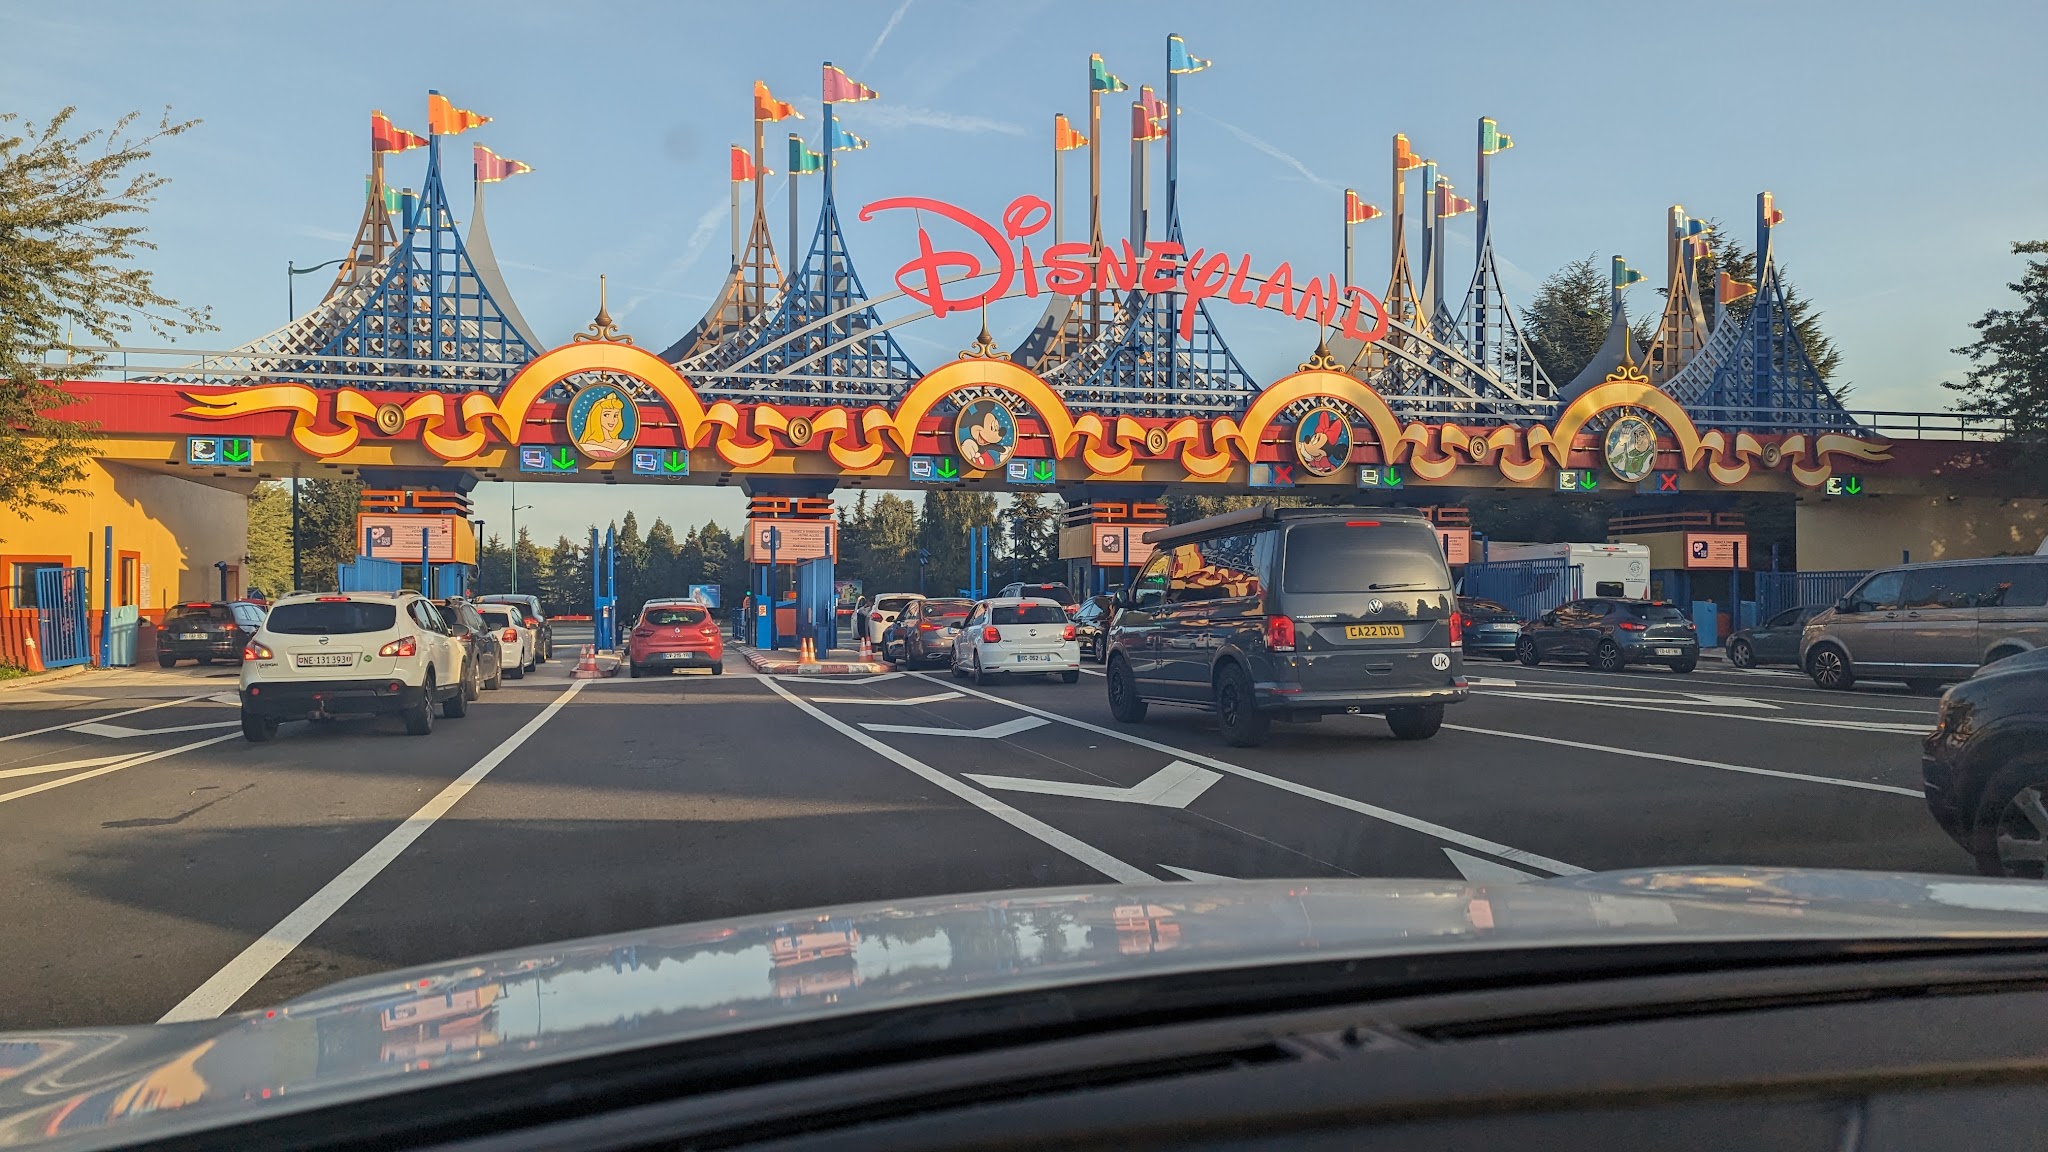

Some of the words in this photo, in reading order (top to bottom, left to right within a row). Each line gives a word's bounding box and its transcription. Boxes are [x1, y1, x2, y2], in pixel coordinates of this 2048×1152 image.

[1350, 626, 1378, 637] CA22
[1380, 626, 1400, 636] DXD
[1433, 657, 1447, 668] UK
